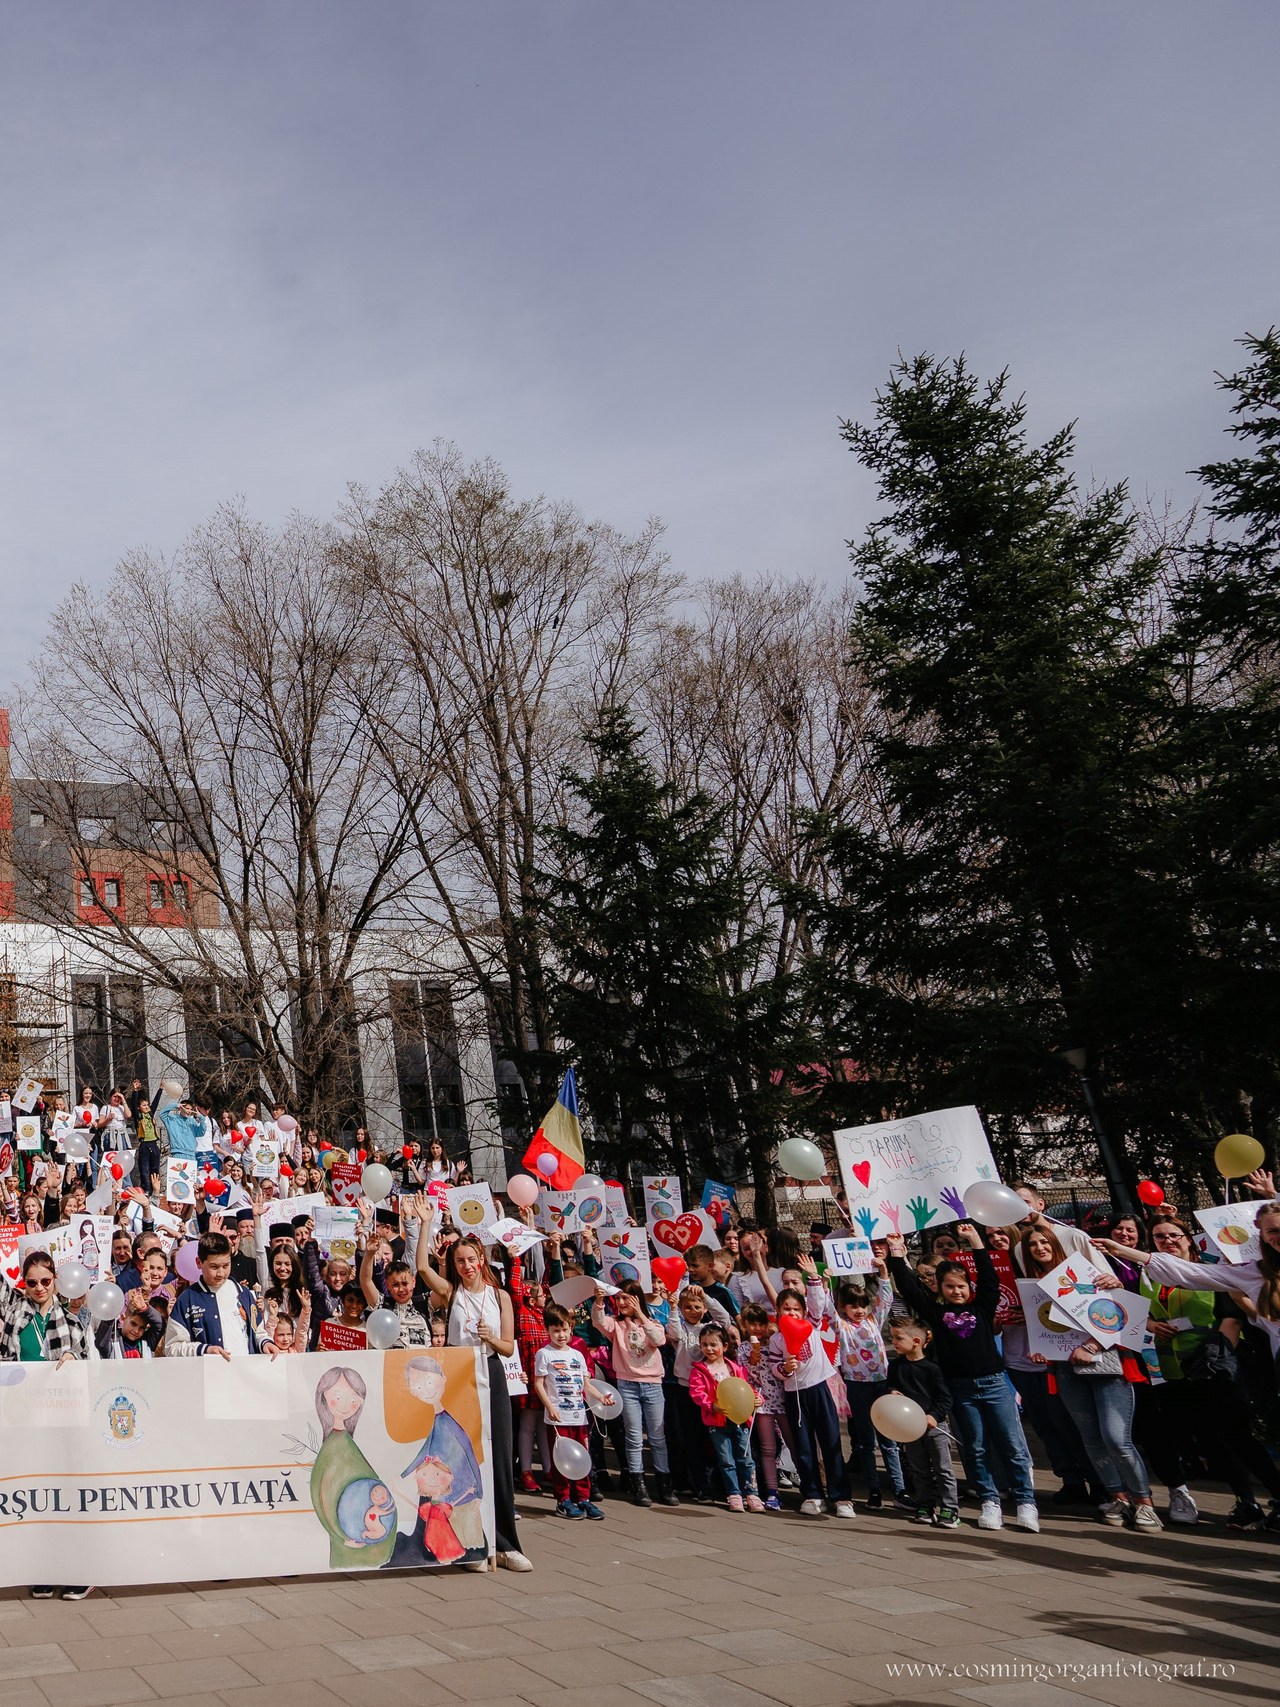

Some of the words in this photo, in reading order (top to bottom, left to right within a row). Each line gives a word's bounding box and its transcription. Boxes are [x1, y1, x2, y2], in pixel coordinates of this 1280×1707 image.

[955, 1254, 1000, 1262] EGALEA
[325, 1326, 360, 1338] EGALITATEA
[78, 1483, 201, 1513] PENTRU
